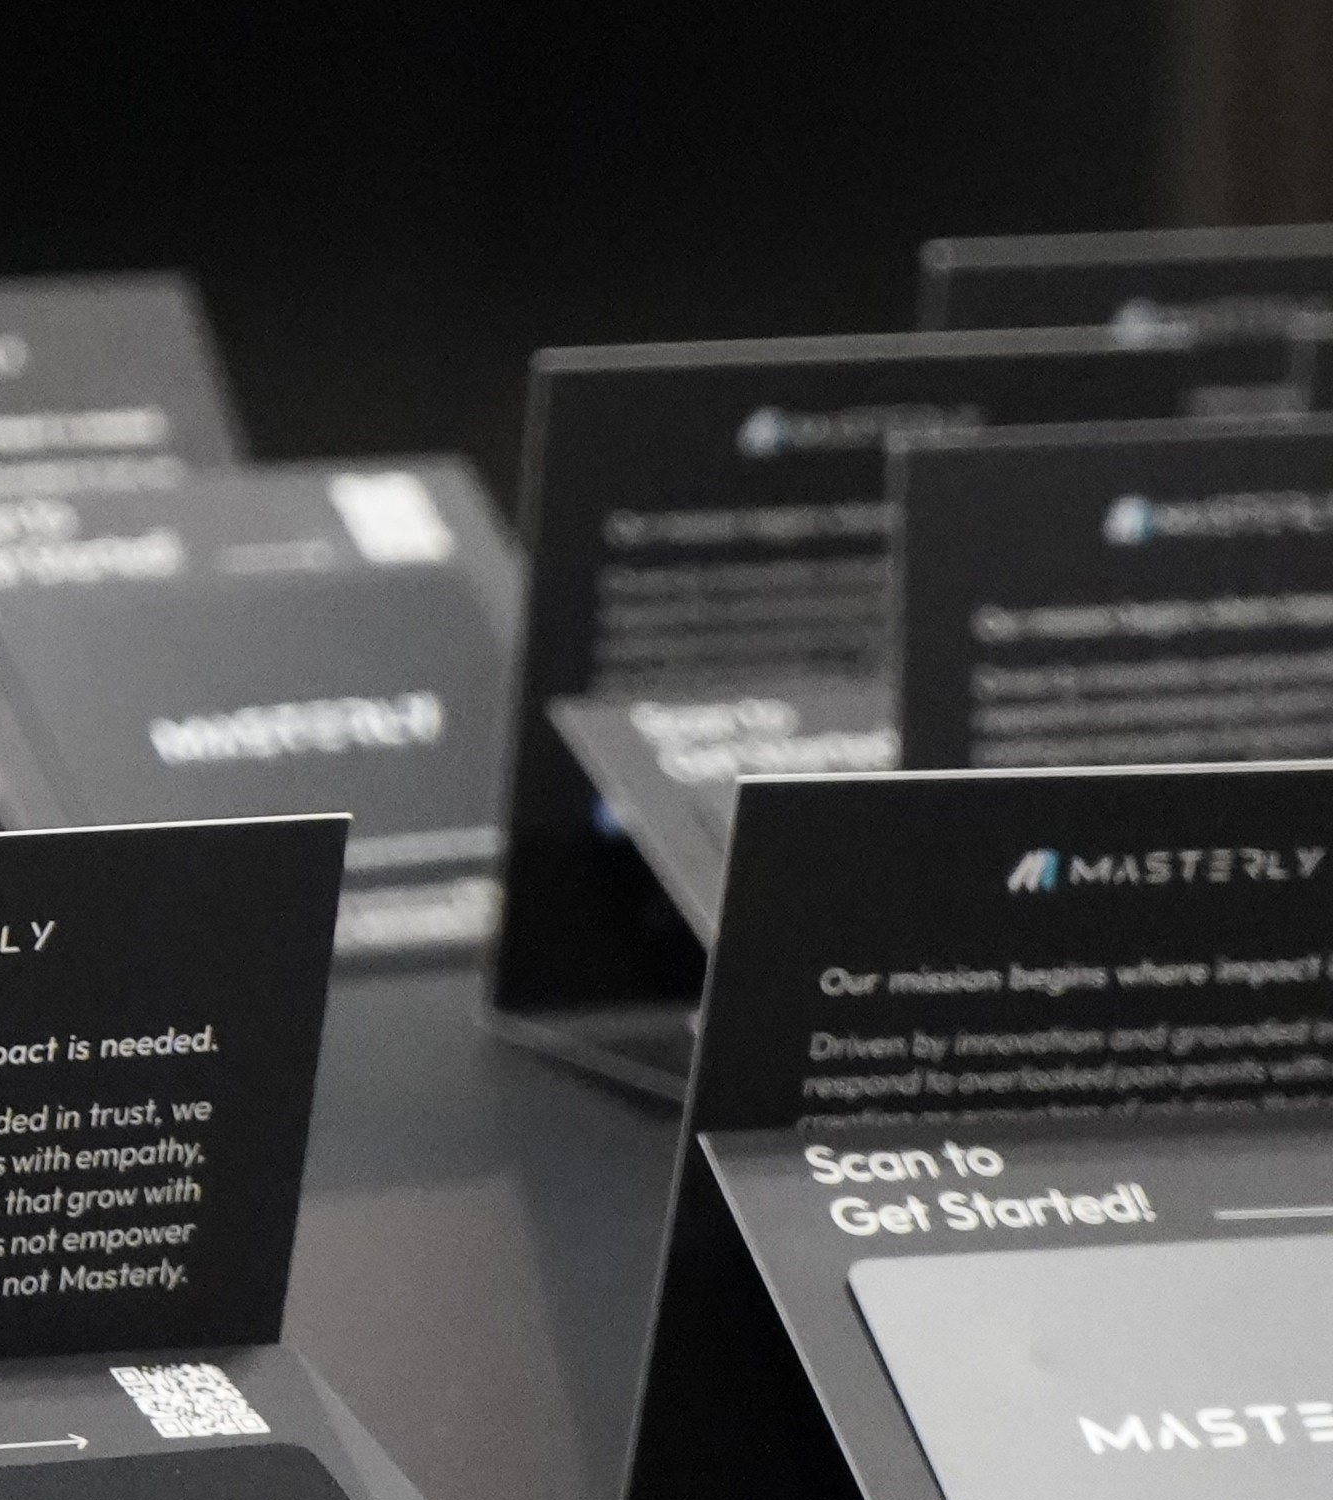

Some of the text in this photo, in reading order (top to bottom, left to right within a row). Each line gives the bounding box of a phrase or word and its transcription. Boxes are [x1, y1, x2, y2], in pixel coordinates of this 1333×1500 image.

[1070, 848, 1324, 884] MASTERLY
[68, 1037, 90, 1060] is
[101, 1025, 217, 1058] needed.
[56, 1107, 80, 1129] in
[90, 1099, 162, 1127] trust,
[172, 1101, 212, 1121] we
[12, 1145, 70, 1173] with
[75, 1137, 204, 1172] empathy,
[5, 1187, 63, 1215] that
[67, 1188, 138, 1217] grow
[144, 1176, 201, 1204] with
[11, 1228, 58, 1254] not
[62, 1224, 196, 1254] empower
[3, 1269, 50, 1296] not
[59, 1258, 187, 1291] Masterly.
[1078, 1403, 1333, 1454] MASTE
